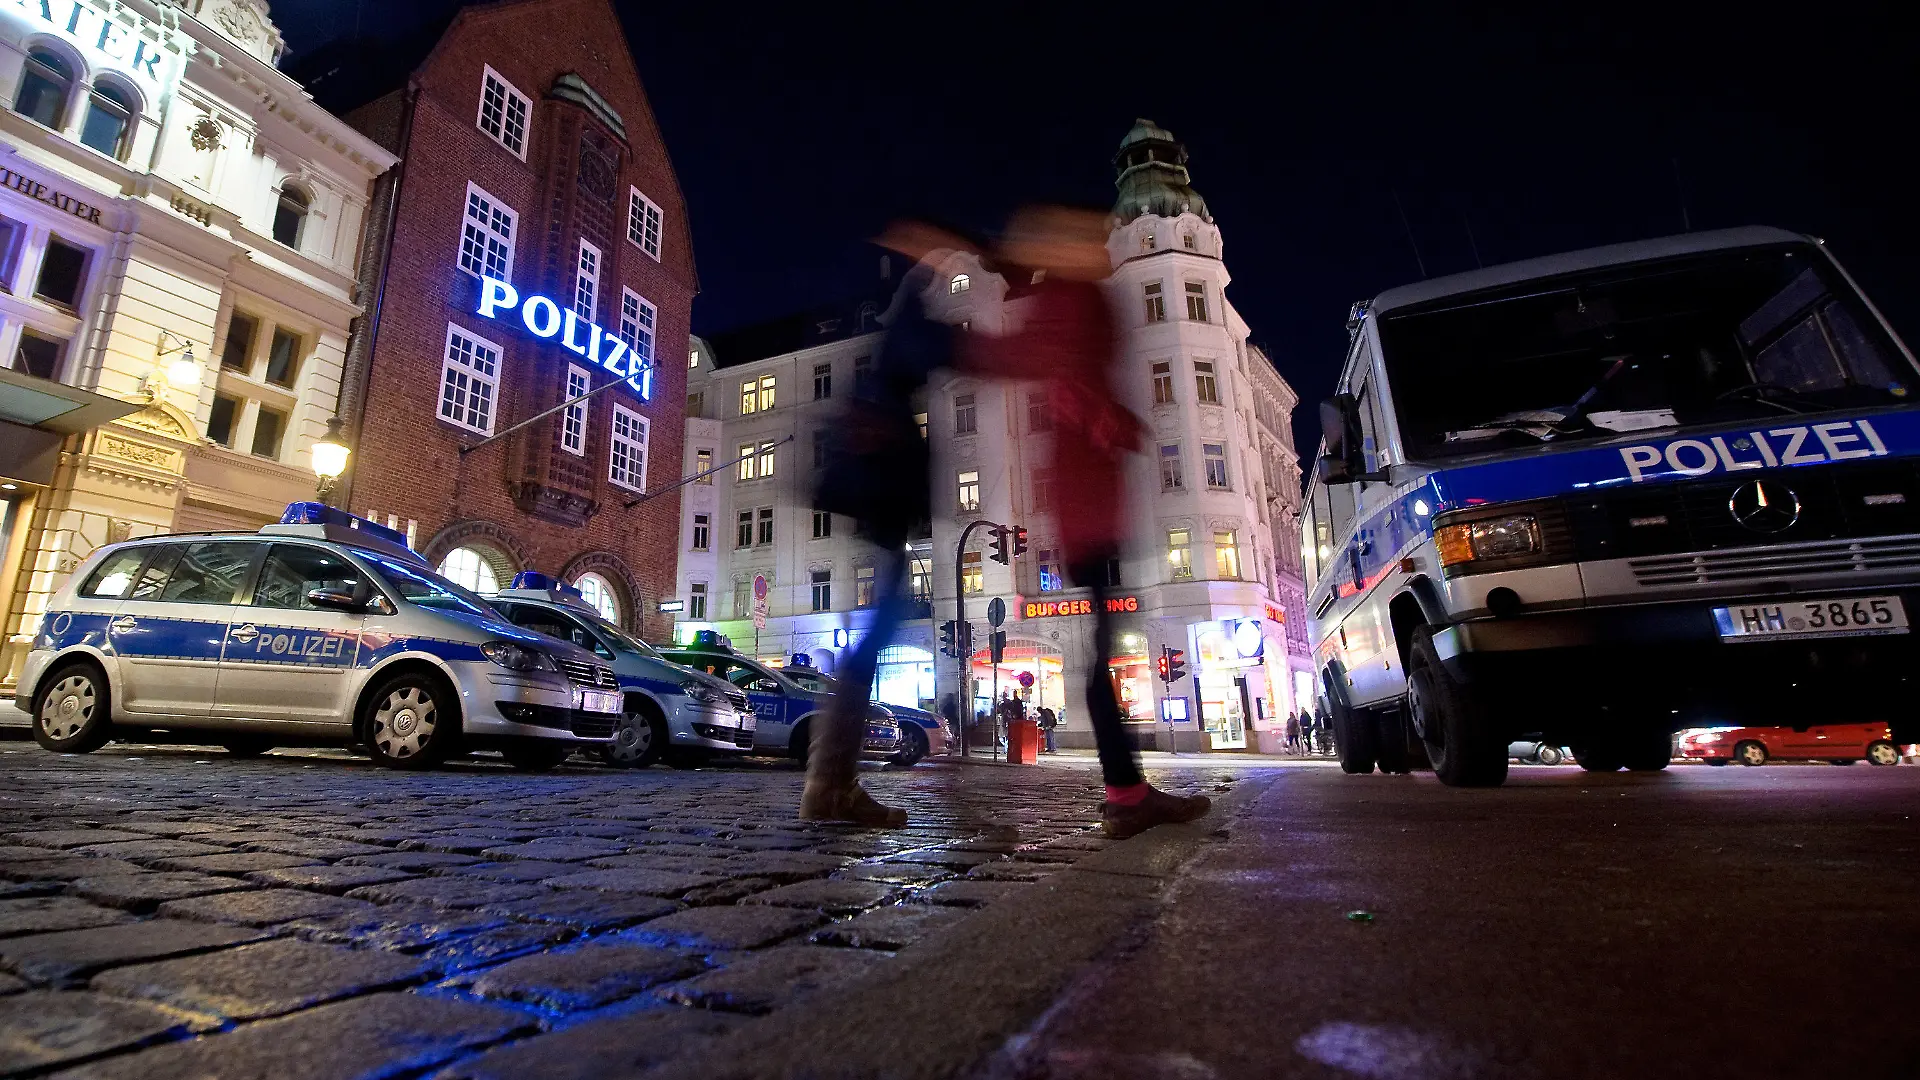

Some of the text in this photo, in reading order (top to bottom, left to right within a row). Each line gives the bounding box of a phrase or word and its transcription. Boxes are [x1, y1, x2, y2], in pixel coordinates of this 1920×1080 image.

[0, 167, 101, 226] THEATER
[476, 274, 653, 400] POLIZEI
[1619, 419, 1888, 483] POLIZEI
[1026, 597, 1138, 617] BURGER ING
[1740, 600, 1893, 633] HH 3865
[256, 633, 345, 658] POLIZEI
